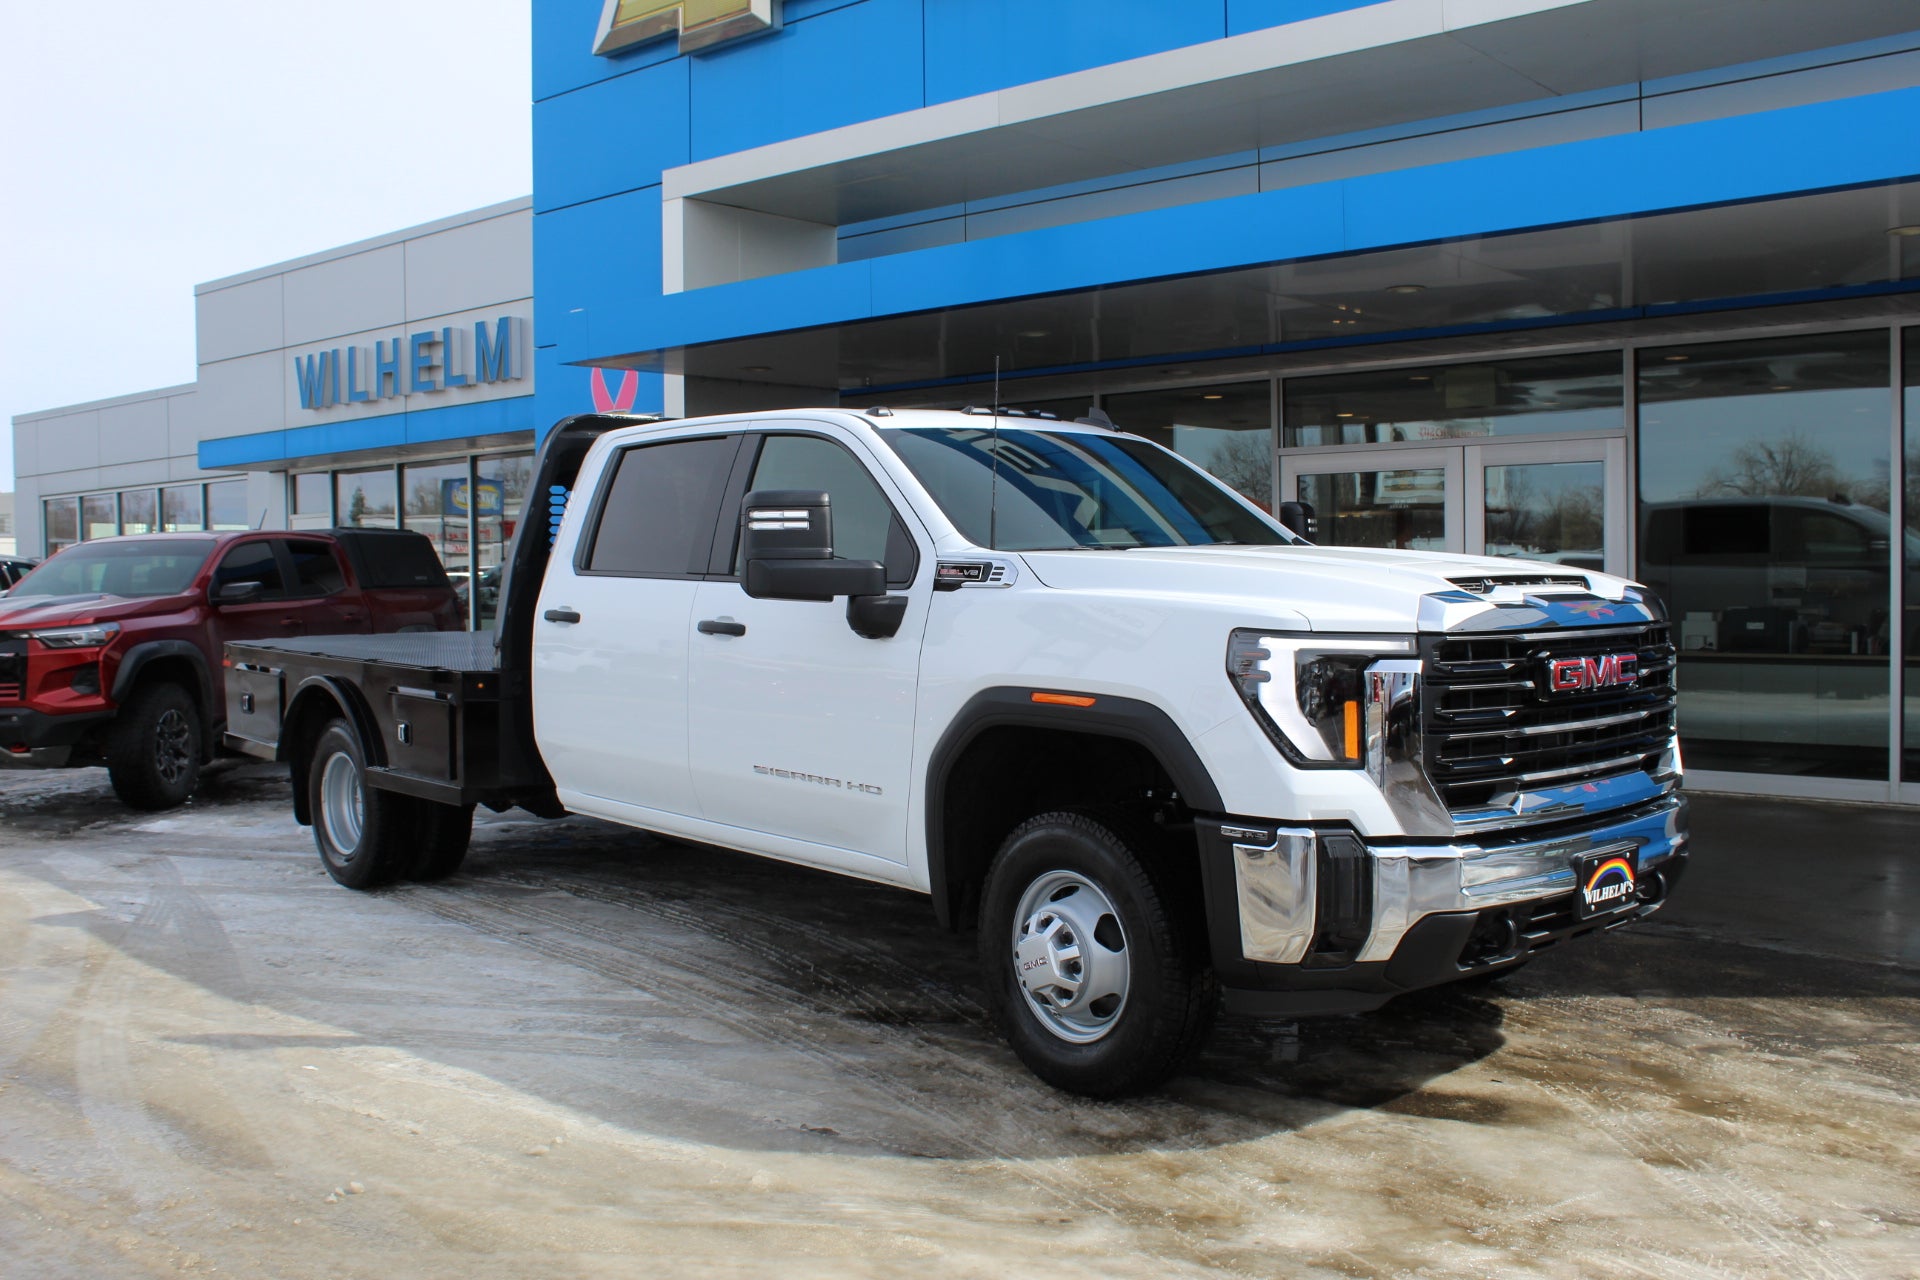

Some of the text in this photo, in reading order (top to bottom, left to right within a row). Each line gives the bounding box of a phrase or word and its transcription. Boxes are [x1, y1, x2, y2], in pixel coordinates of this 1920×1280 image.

[295, 316, 522, 410] WILHELM
[1549, 653, 1638, 692] GMC
[753, 765, 883, 796] SIERRA HD
[1583, 880, 1634, 904] WILHELM'S
[1023, 956, 1049, 971] GMC
